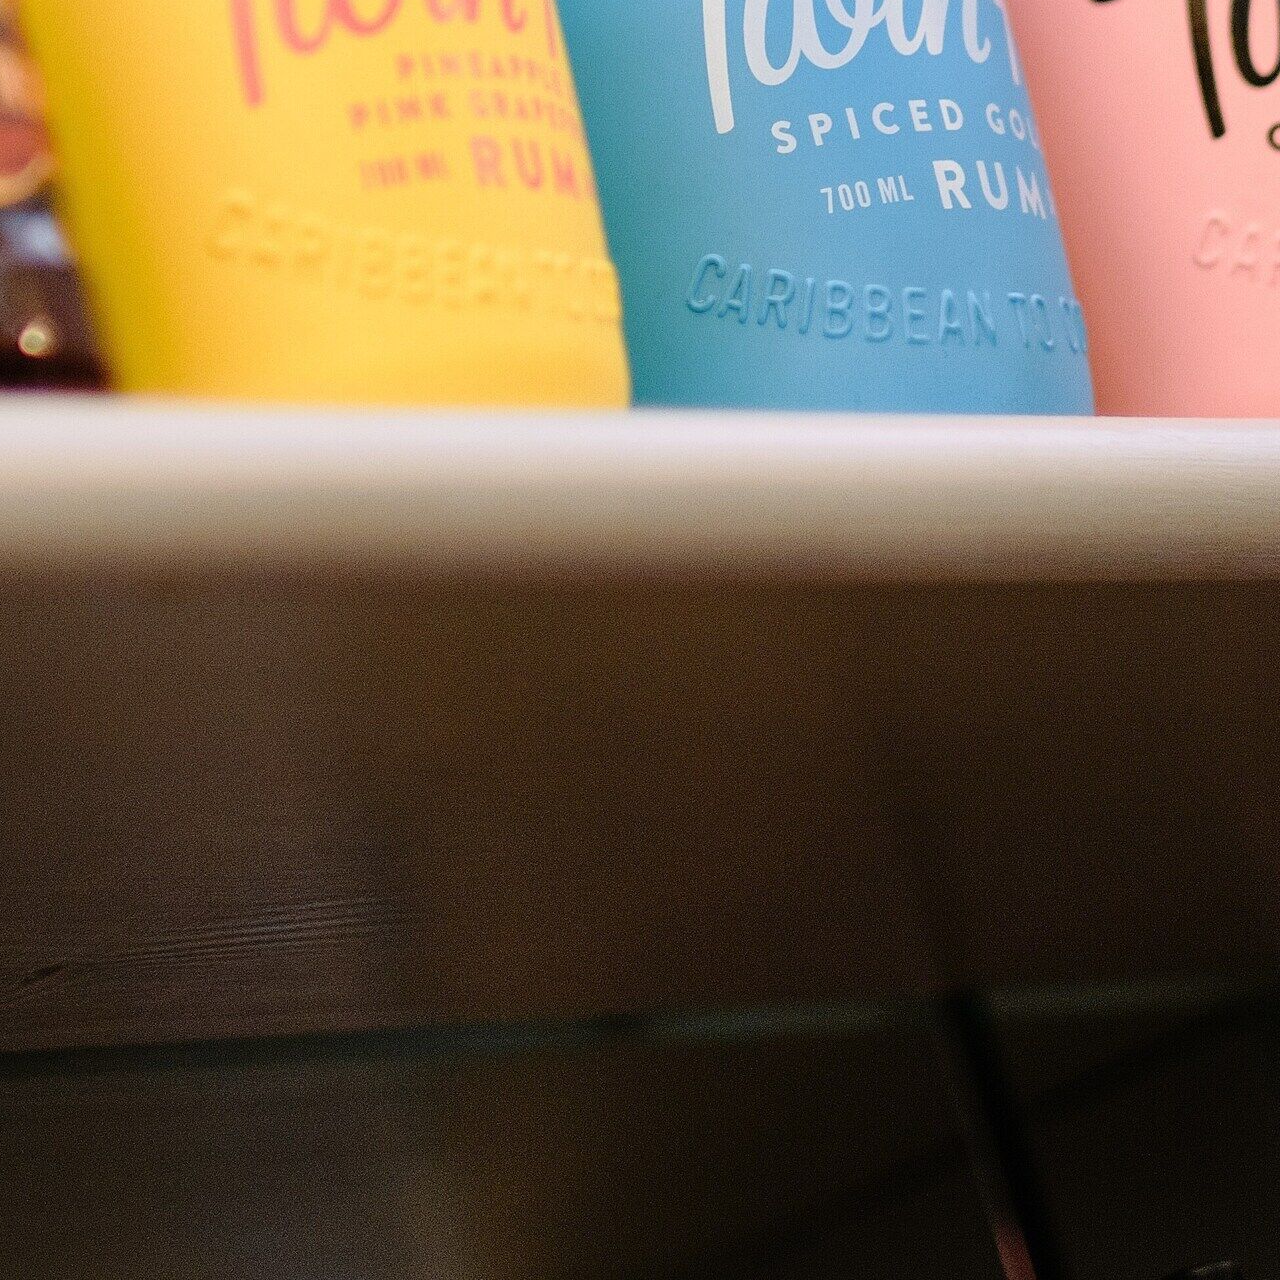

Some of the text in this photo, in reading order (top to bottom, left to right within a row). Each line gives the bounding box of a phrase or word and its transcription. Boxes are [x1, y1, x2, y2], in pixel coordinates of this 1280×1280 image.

[770, 98, 1043, 155] SPICED GOL
[468, 134, 583, 202] RUM
[820, 181, 871, 214] 700
[877, 175, 915, 205] ML
[932, 159, 1048, 221] RUM
[687, 253, 999, 349] CARIBBEAN
